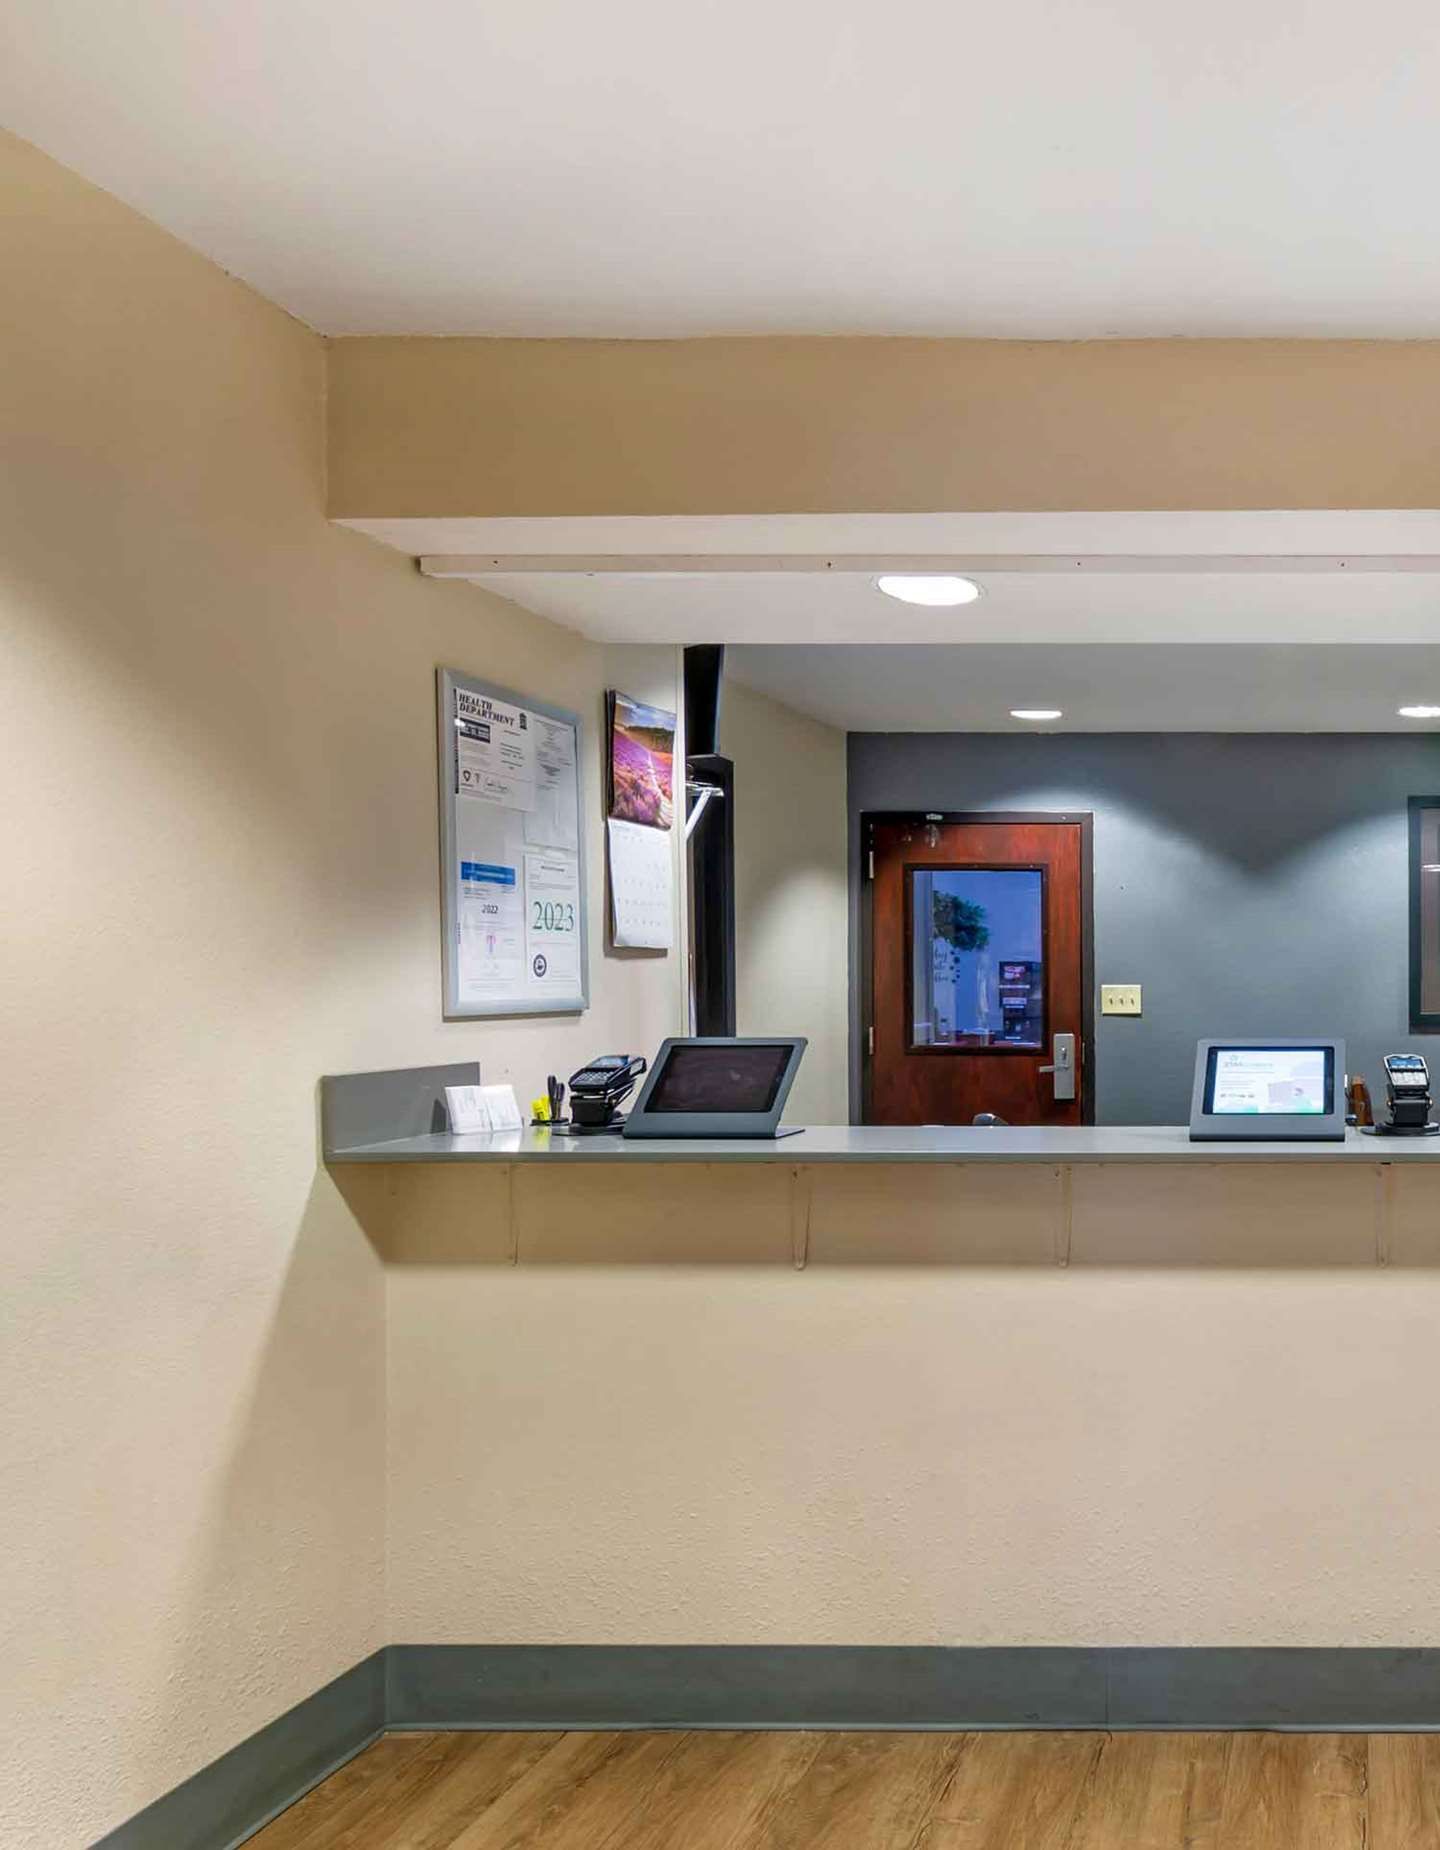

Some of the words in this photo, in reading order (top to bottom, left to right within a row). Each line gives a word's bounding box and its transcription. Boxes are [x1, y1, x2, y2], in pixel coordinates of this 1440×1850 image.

[458, 693, 493, 710] HEALTH
[459, 702, 515, 727] DEPARTMENT
[481, 903, 499, 914] 2022
[532, 901, 575, 932] 2023
